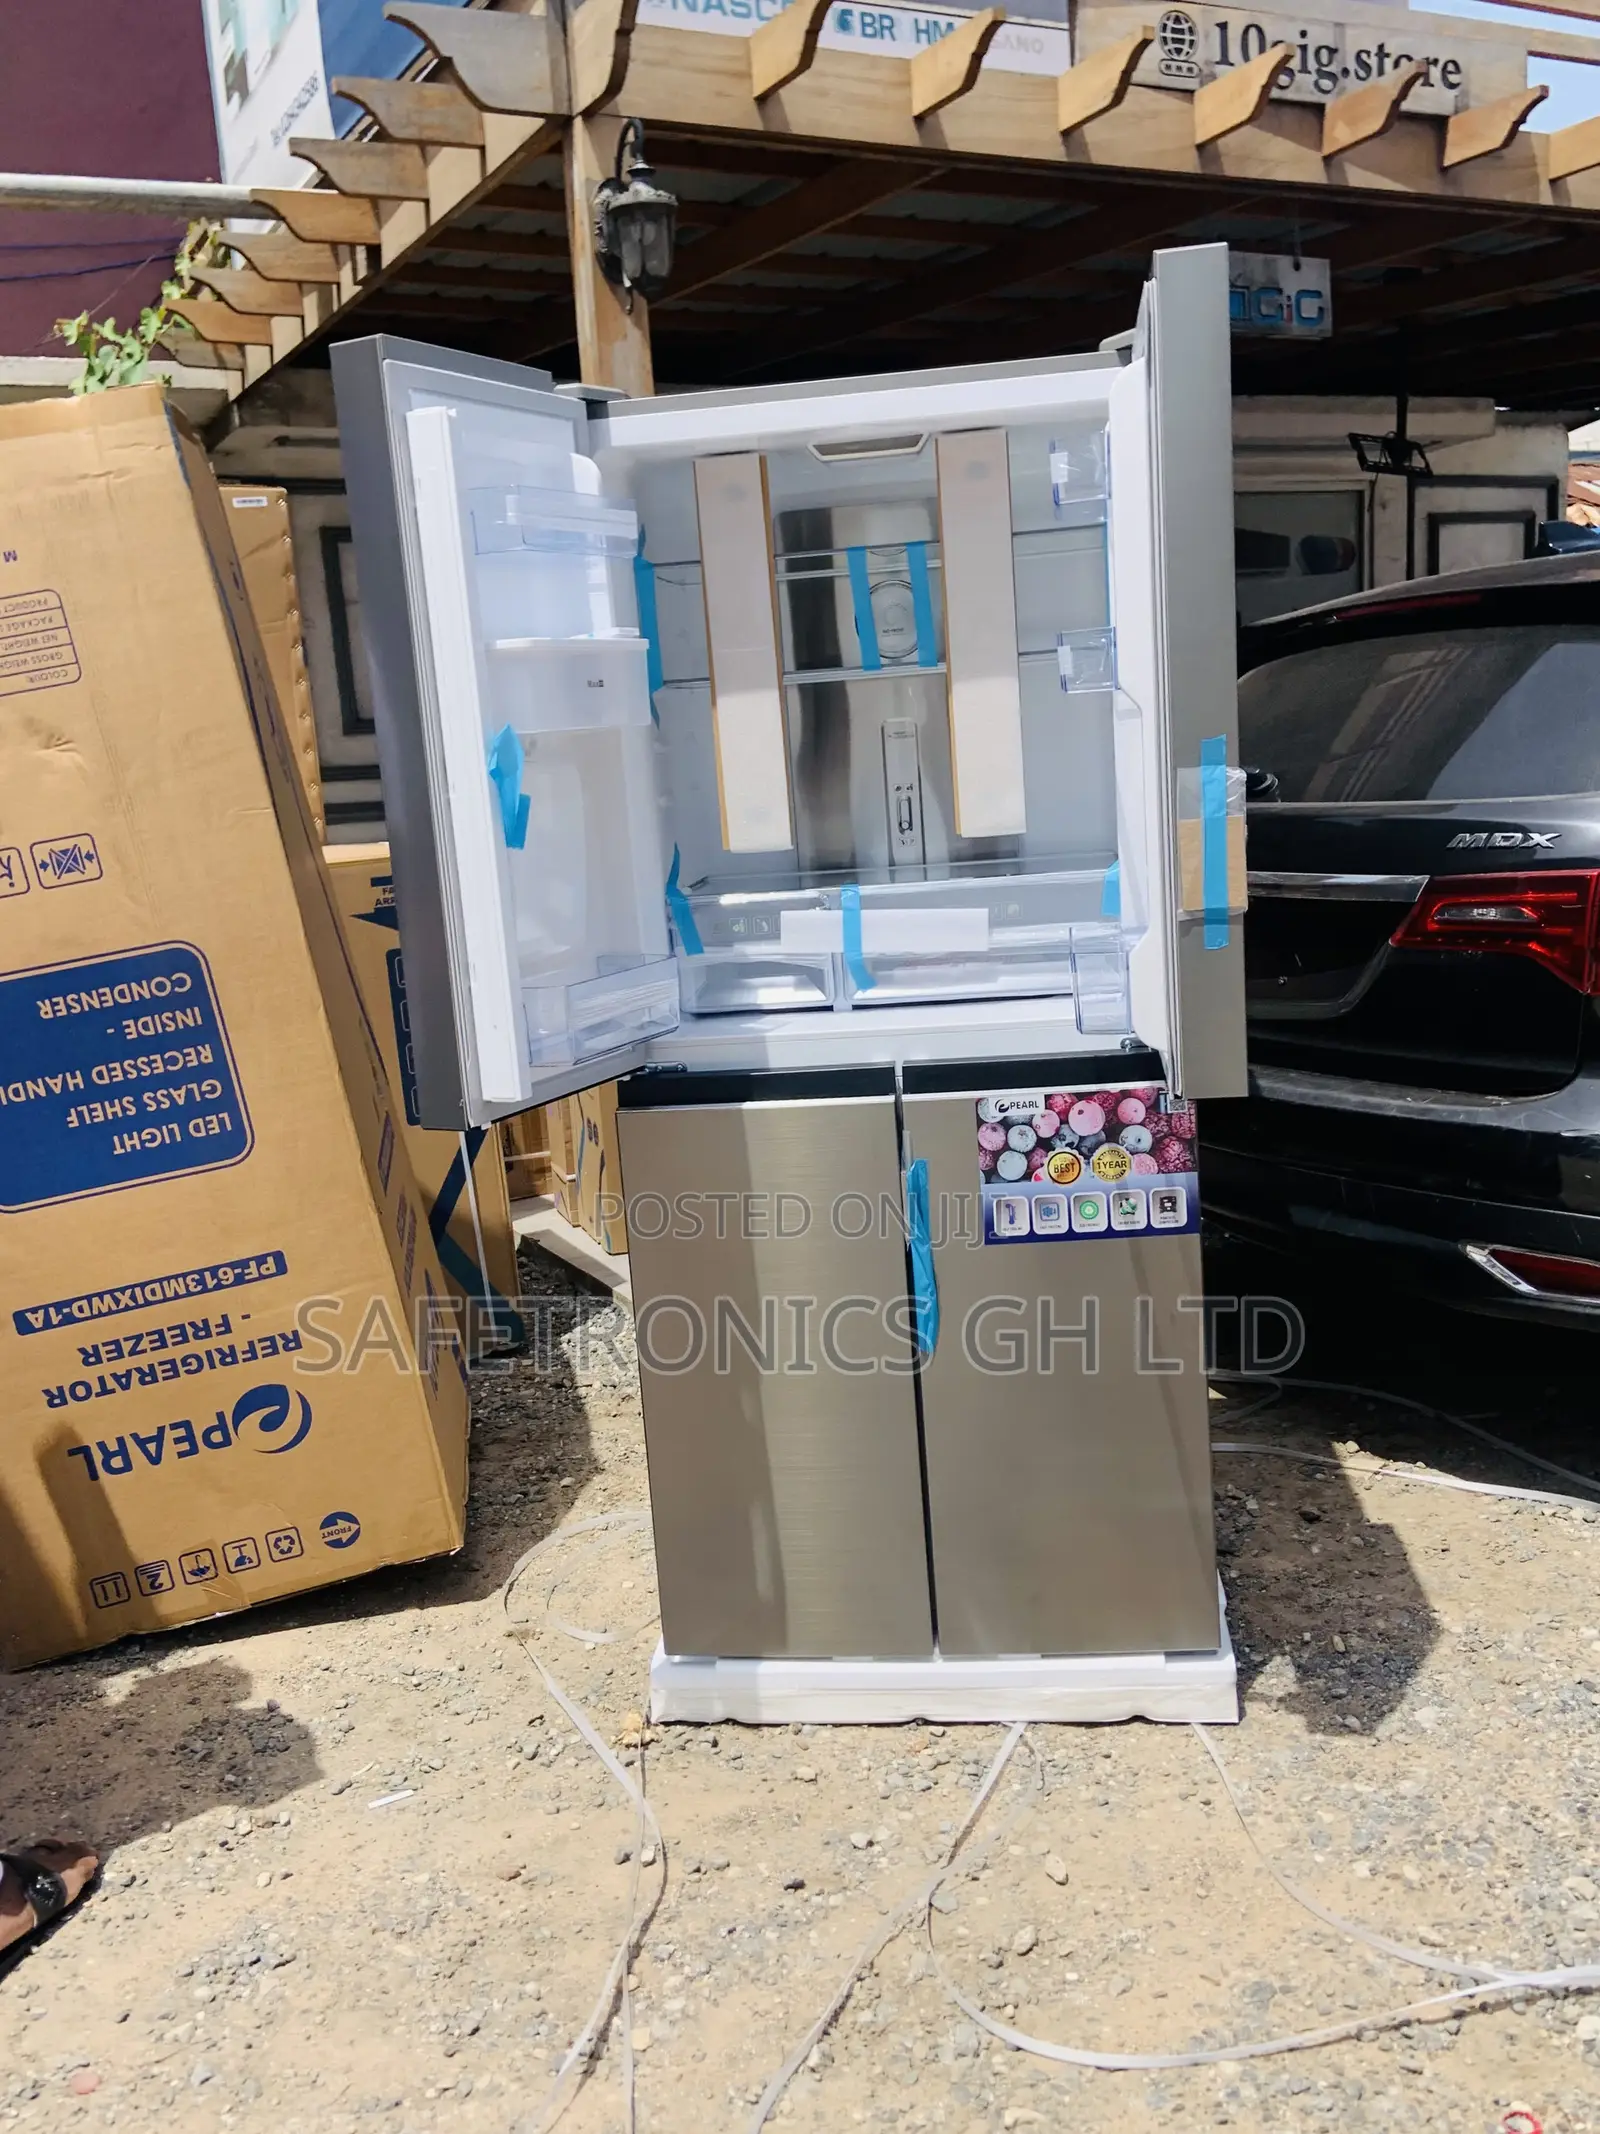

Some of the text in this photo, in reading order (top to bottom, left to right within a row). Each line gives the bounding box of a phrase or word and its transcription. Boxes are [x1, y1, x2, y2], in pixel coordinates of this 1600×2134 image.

[1446, 832, 1562, 849] MDX
[36, 972, 192, 1019] CONDENSER
[122, 1006, 203, 1040] INSIDE
[91, 1043, 214, 1085] RECESSED
[66, 1079, 222, 1128] GLASS SHELF
[1010, 1099, 1040, 1110] PEARL
[113, 1111, 232, 1155] LED LIGHT
[1053, 1162, 1076, 1174] BEST
[1102, 1160, 1127, 1169] YEAR
[25, 1256, 278, 1330] PF-613MDIXWD-1A
[77, 1313, 234, 1368] FREEZER
[41, 1329, 304, 1409] REFRIGERATOR
[67, 1410, 233, 1482] PEARL
[321, 1526, 352, 1540] FRONT
